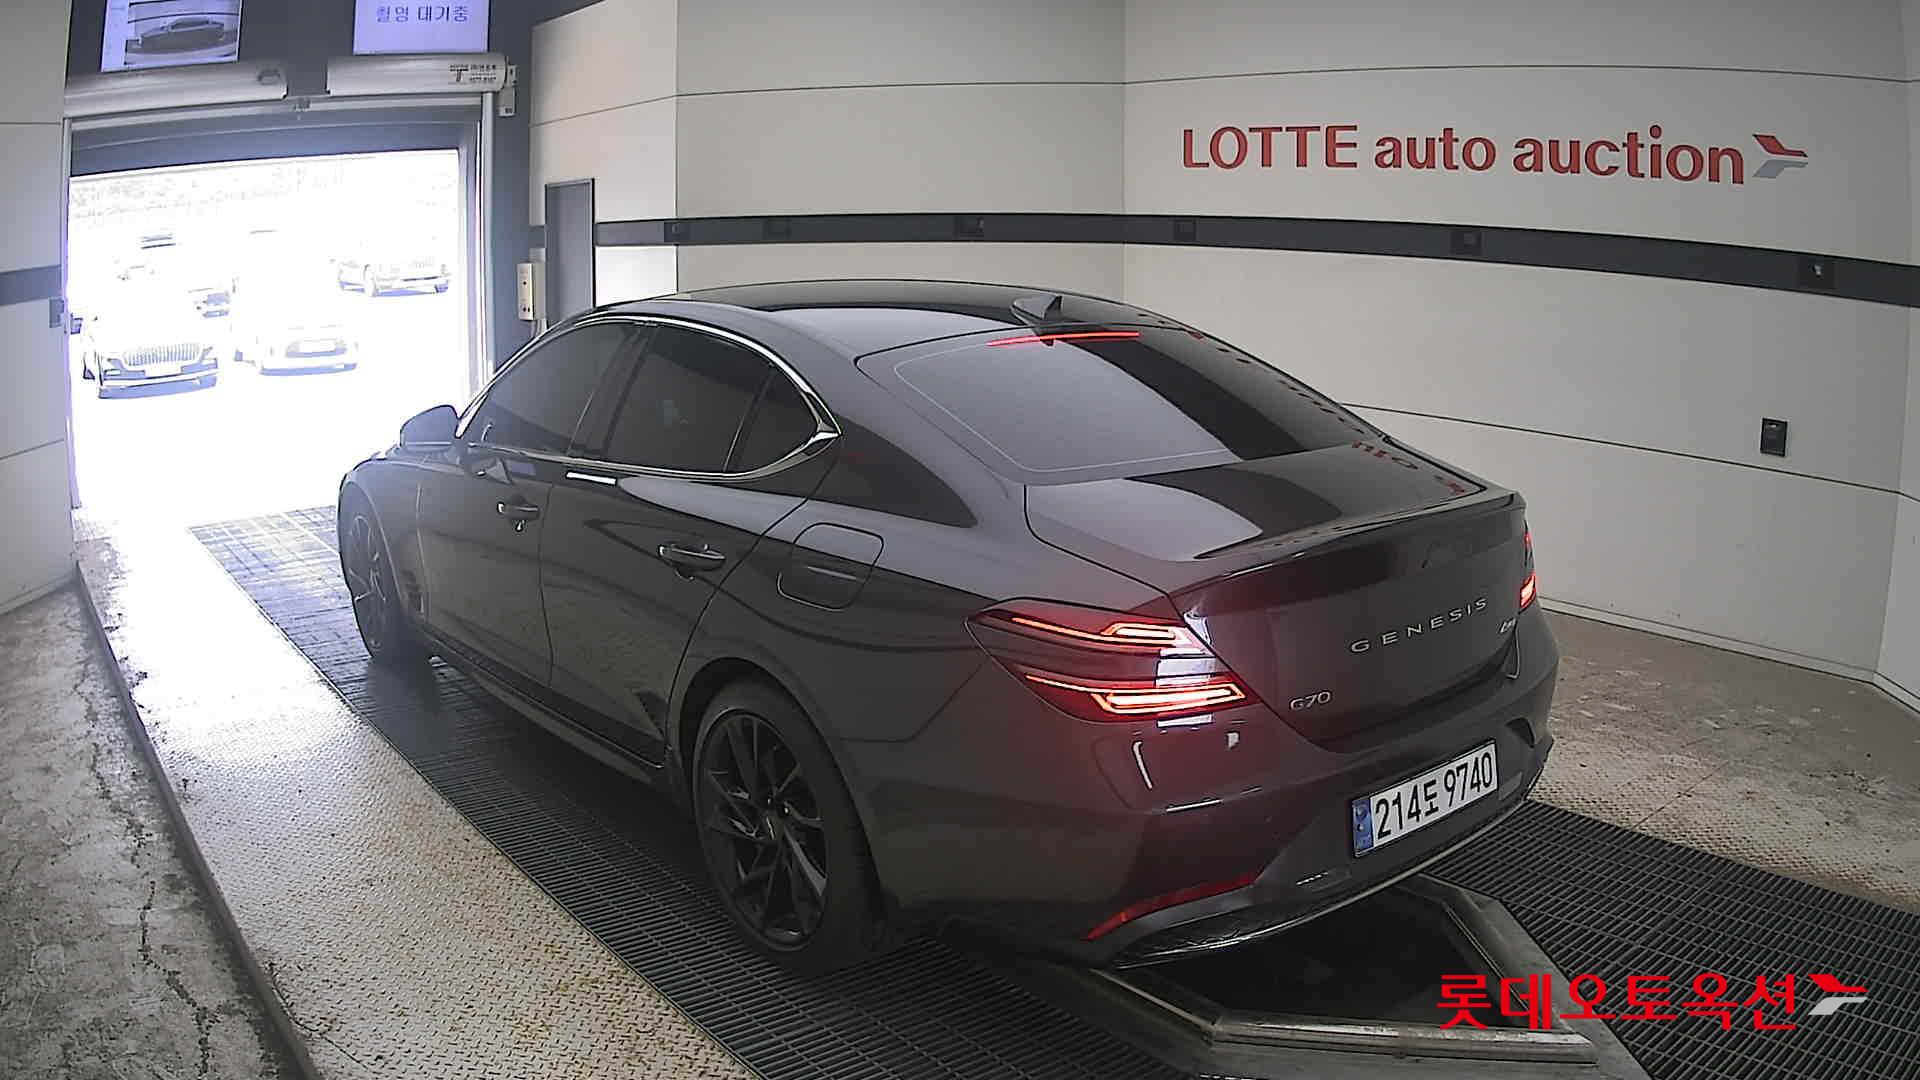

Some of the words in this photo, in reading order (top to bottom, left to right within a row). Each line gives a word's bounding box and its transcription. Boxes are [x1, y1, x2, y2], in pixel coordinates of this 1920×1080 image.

[417, 6, 468, 22] 대기중
[1183, 125, 1358, 169] LOTTE
[1374, 127, 1497, 171] auto
[1512, 124, 1744, 185] auction
[1350, 597, 1487, 653] GENESIS
[1290, 690, 1331, 711] G70
[1375, 778, 1439, 840] 214도
[1443, 751, 1492, 807] 9740
